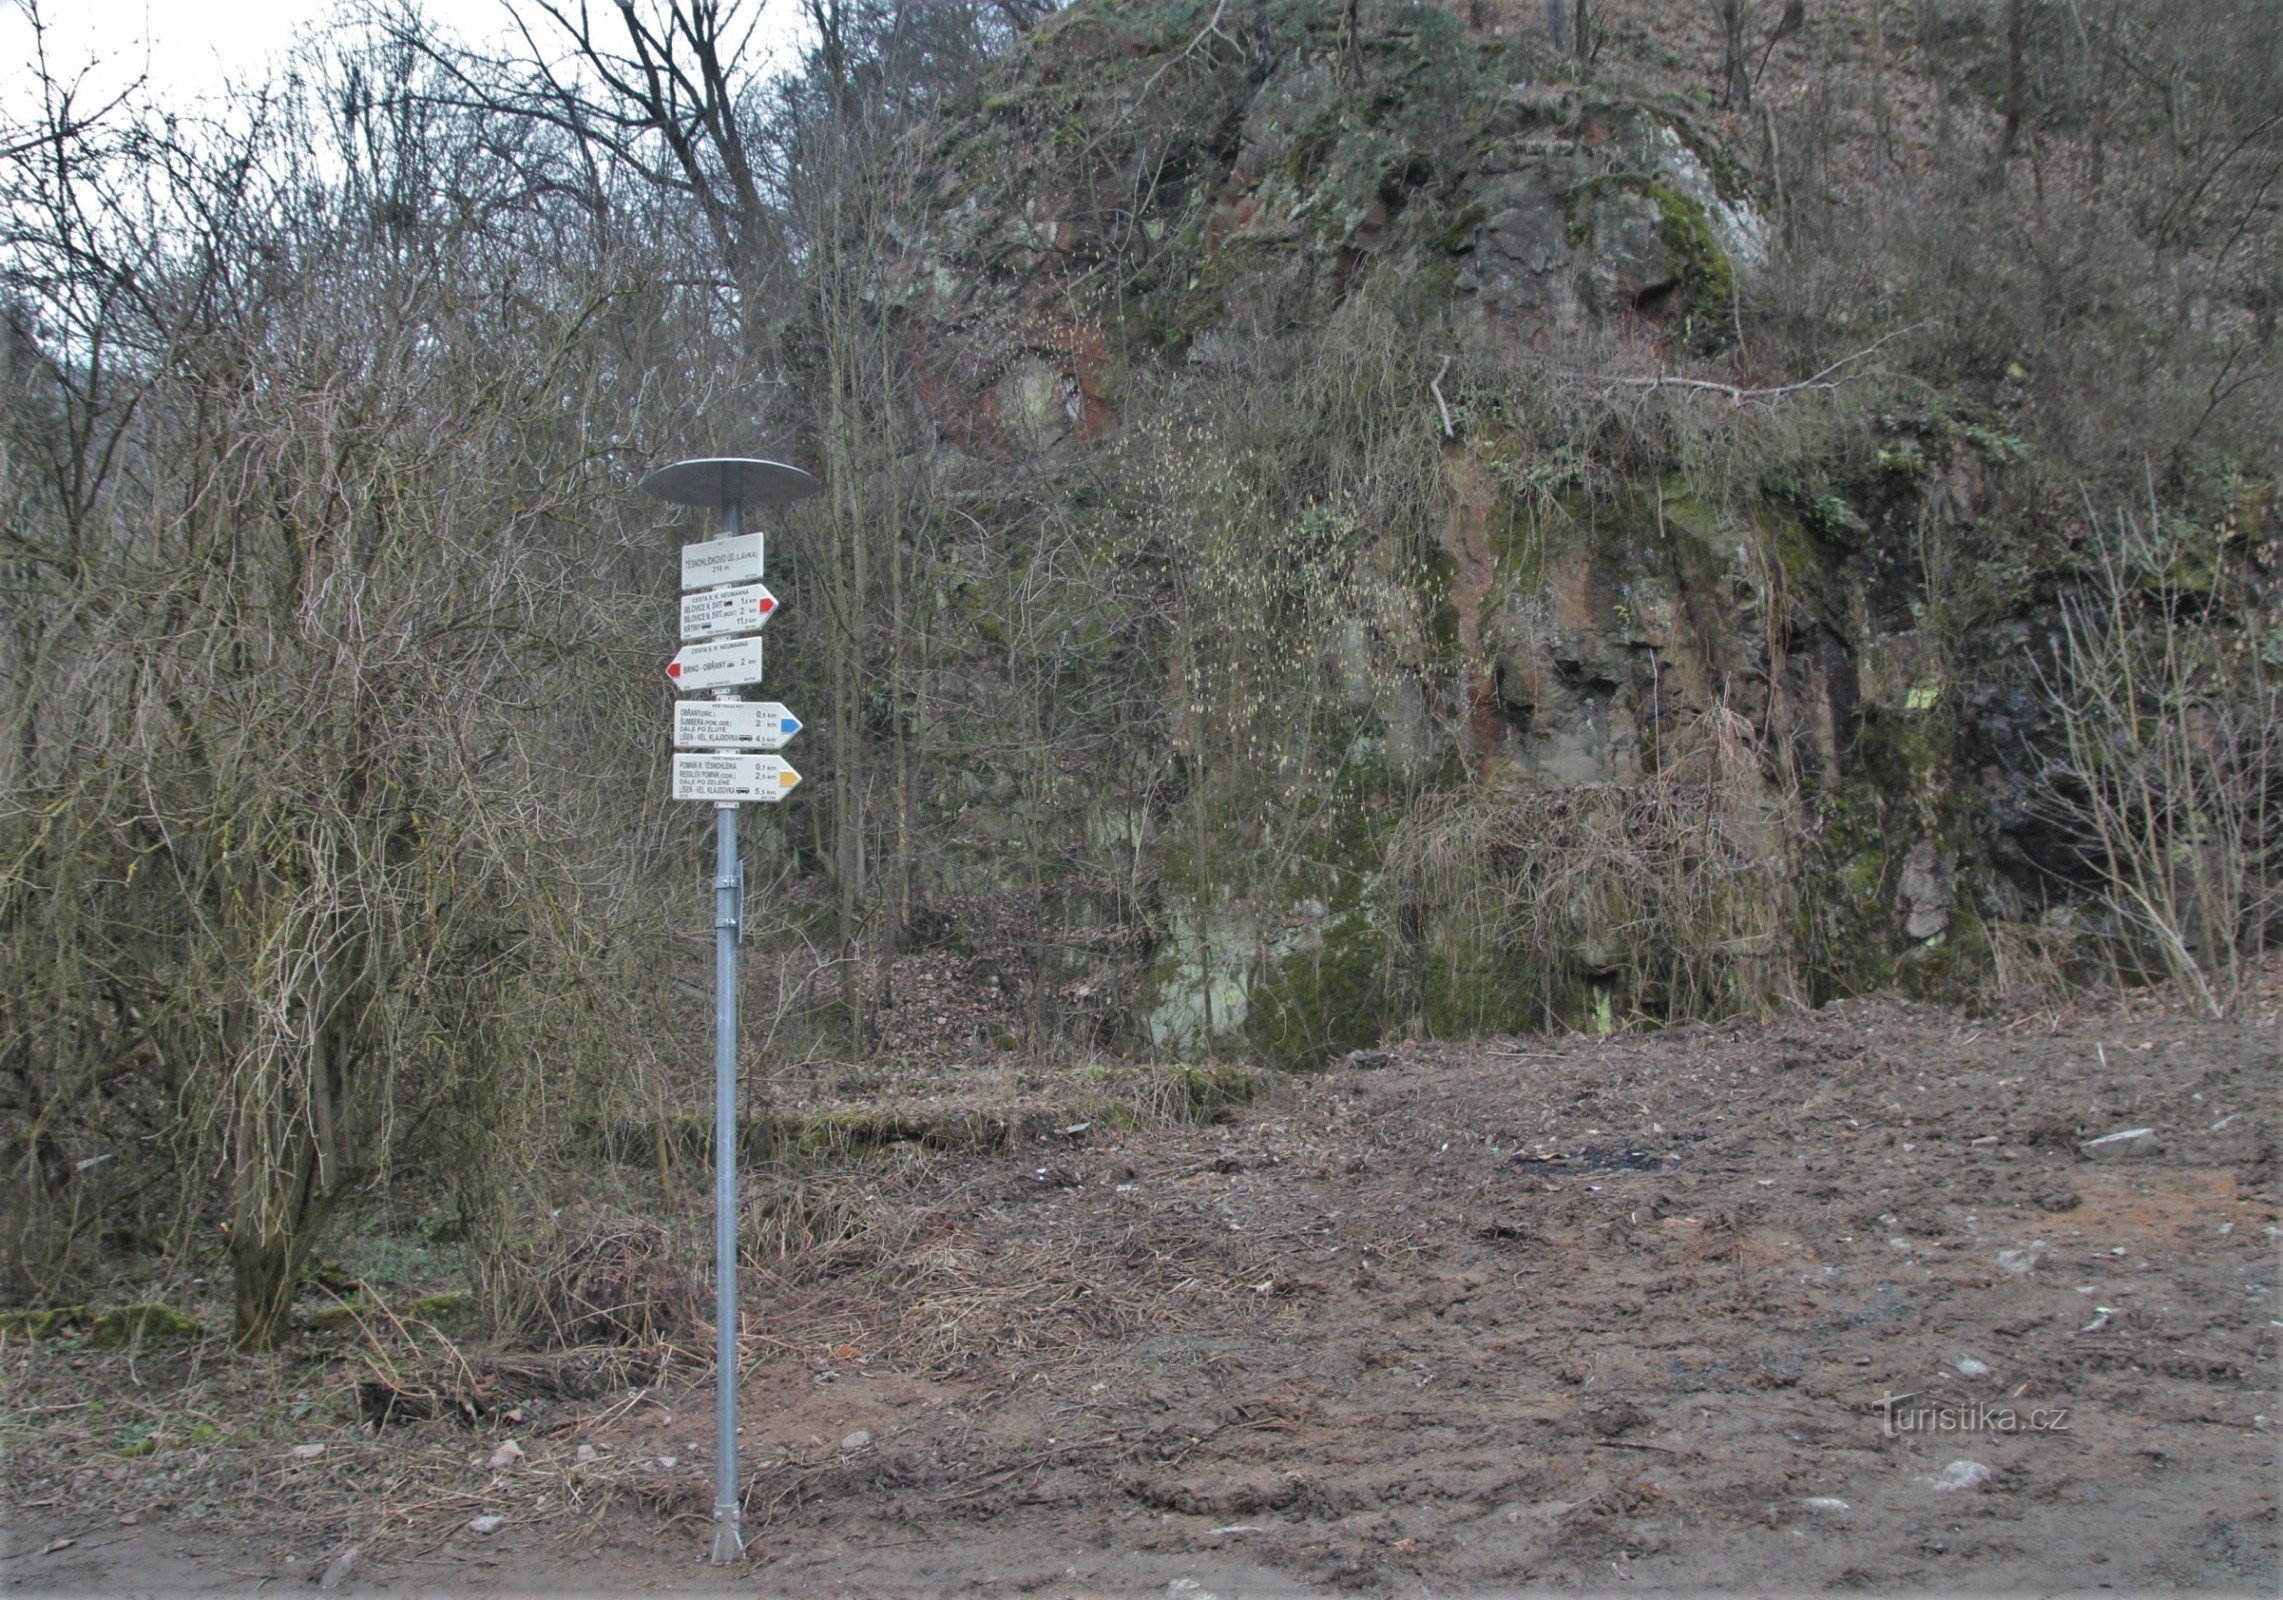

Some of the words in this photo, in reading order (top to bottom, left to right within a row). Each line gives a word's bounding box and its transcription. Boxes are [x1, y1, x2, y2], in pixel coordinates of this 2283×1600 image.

[721, 589, 749, 599] NEUMANNA
[740, 607, 745, 615] 2
[720, 640, 749, 650] NEUMANNA
[683, 664, 700, 674] BRNO
[703, 660, 726, 671] OBŘANY
[740, 658, 746, 666] 2
[754, 772, 766, 780] 2,5
[754, 787, 766, 795] 5,5
